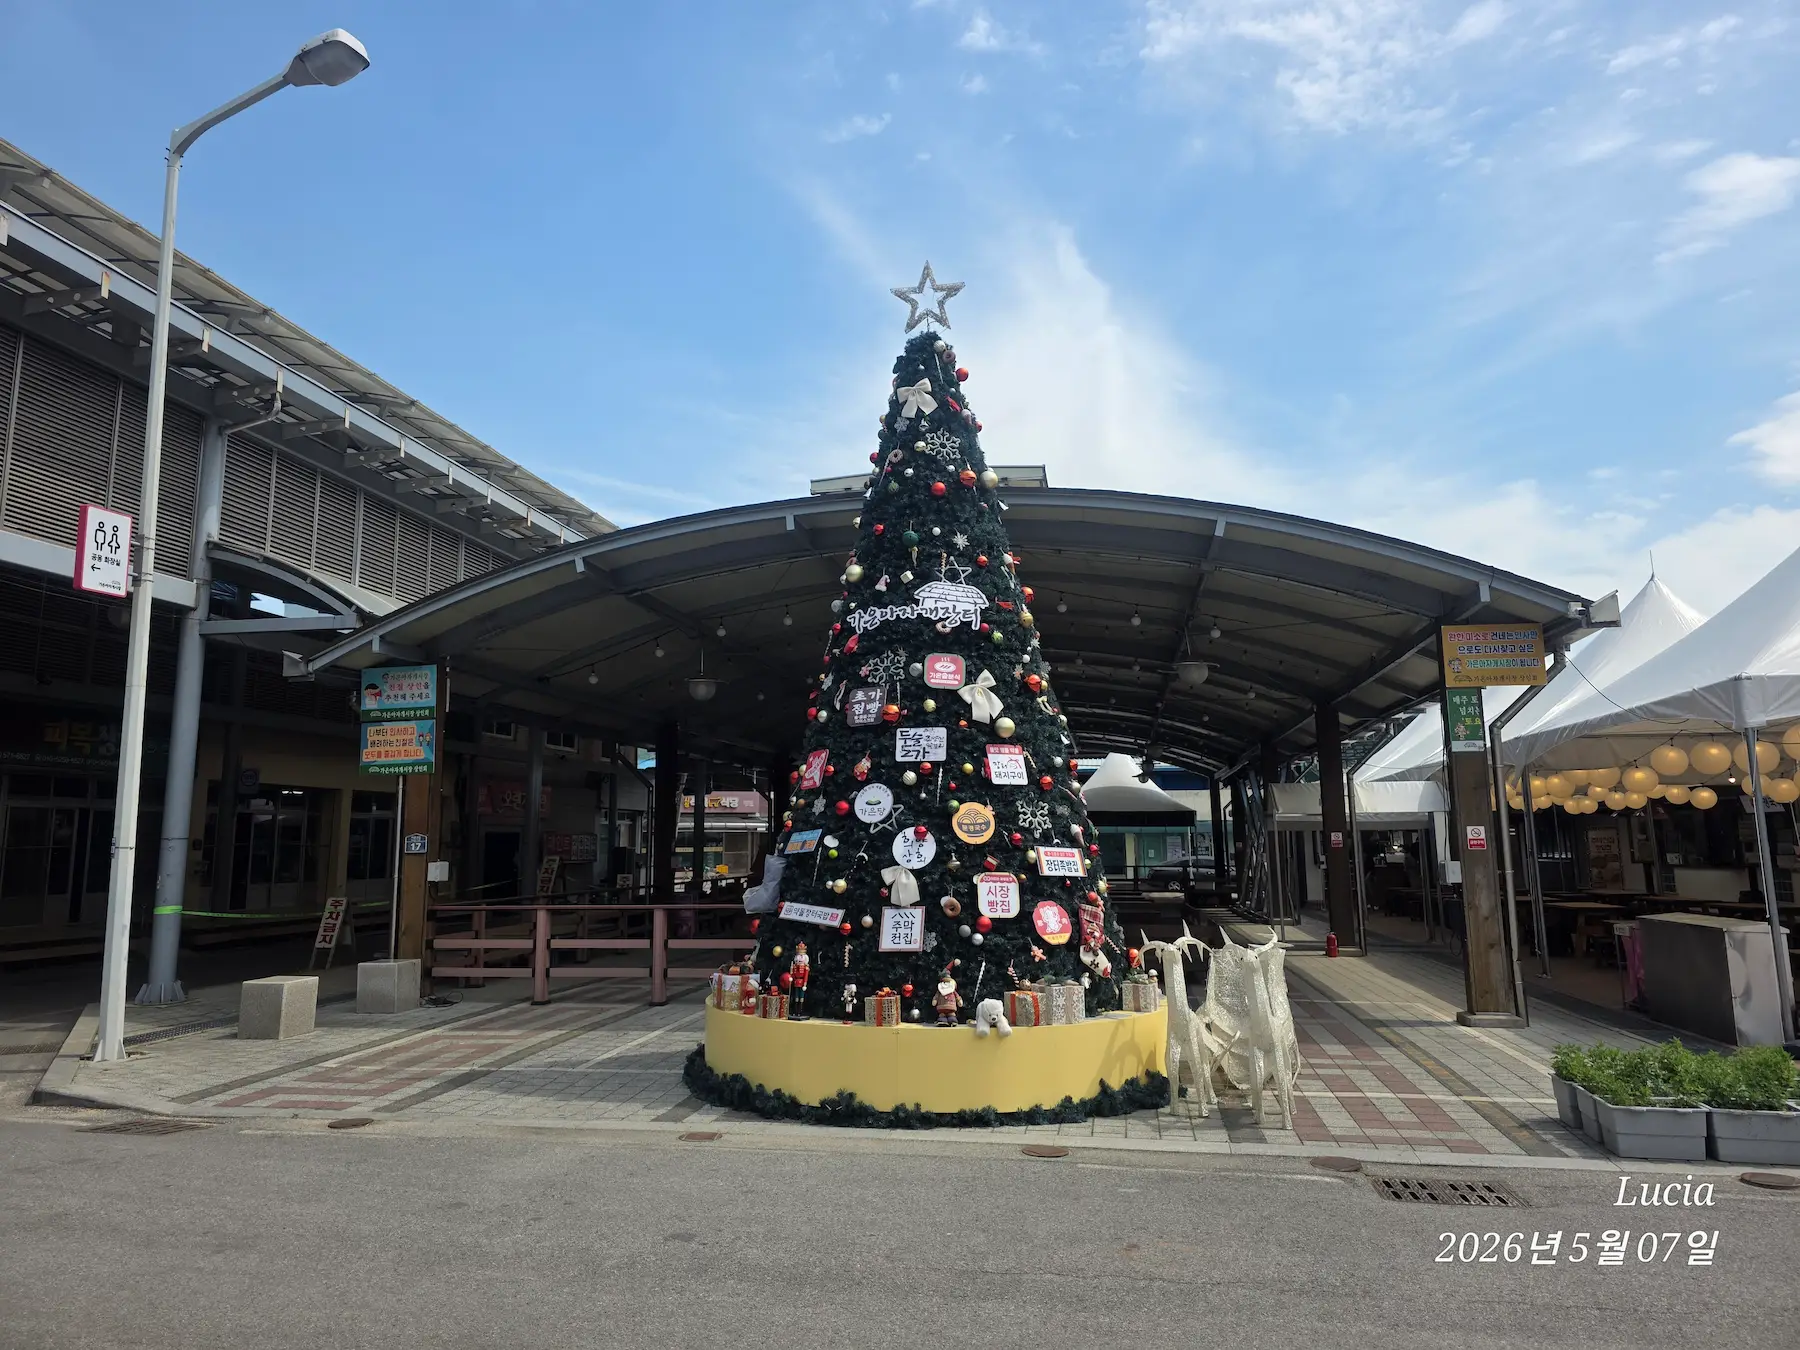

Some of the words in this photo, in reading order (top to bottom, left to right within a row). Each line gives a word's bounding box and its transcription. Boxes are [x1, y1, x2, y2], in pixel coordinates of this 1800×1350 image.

[91, 553, 102, 562] 공용
[104, 556, 120, 566] 화장실
[848, 605, 980, 633] 가은아자개장터
[1466, 631, 1489, 641] 미소로
[1458, 646, 1481, 654] 으로도
[1519, 644, 1534, 653] 싶은
[410, 692, 430, 700] 주세요
[851, 688, 883, 702] 초가
[1453, 696, 1468, 704] 매주
[851, 701, 882, 714] 점빵
[368, 728, 388, 737] 나부터
[389, 727, 415, 736] 인사하고
[364, 750, 382, 759] 모두를
[995, 771, 1024, 779] 돼지구이
[859, 807, 886, 817] 가은당
[410, 842, 421, 851] 17
[1045, 860, 1079, 873] 장터족발집
[987, 885, 1010, 899] 시장
[988, 900, 1011, 914] 빵집
[891, 920, 915, 932] 주막
[891, 932, 913, 945] 전집
